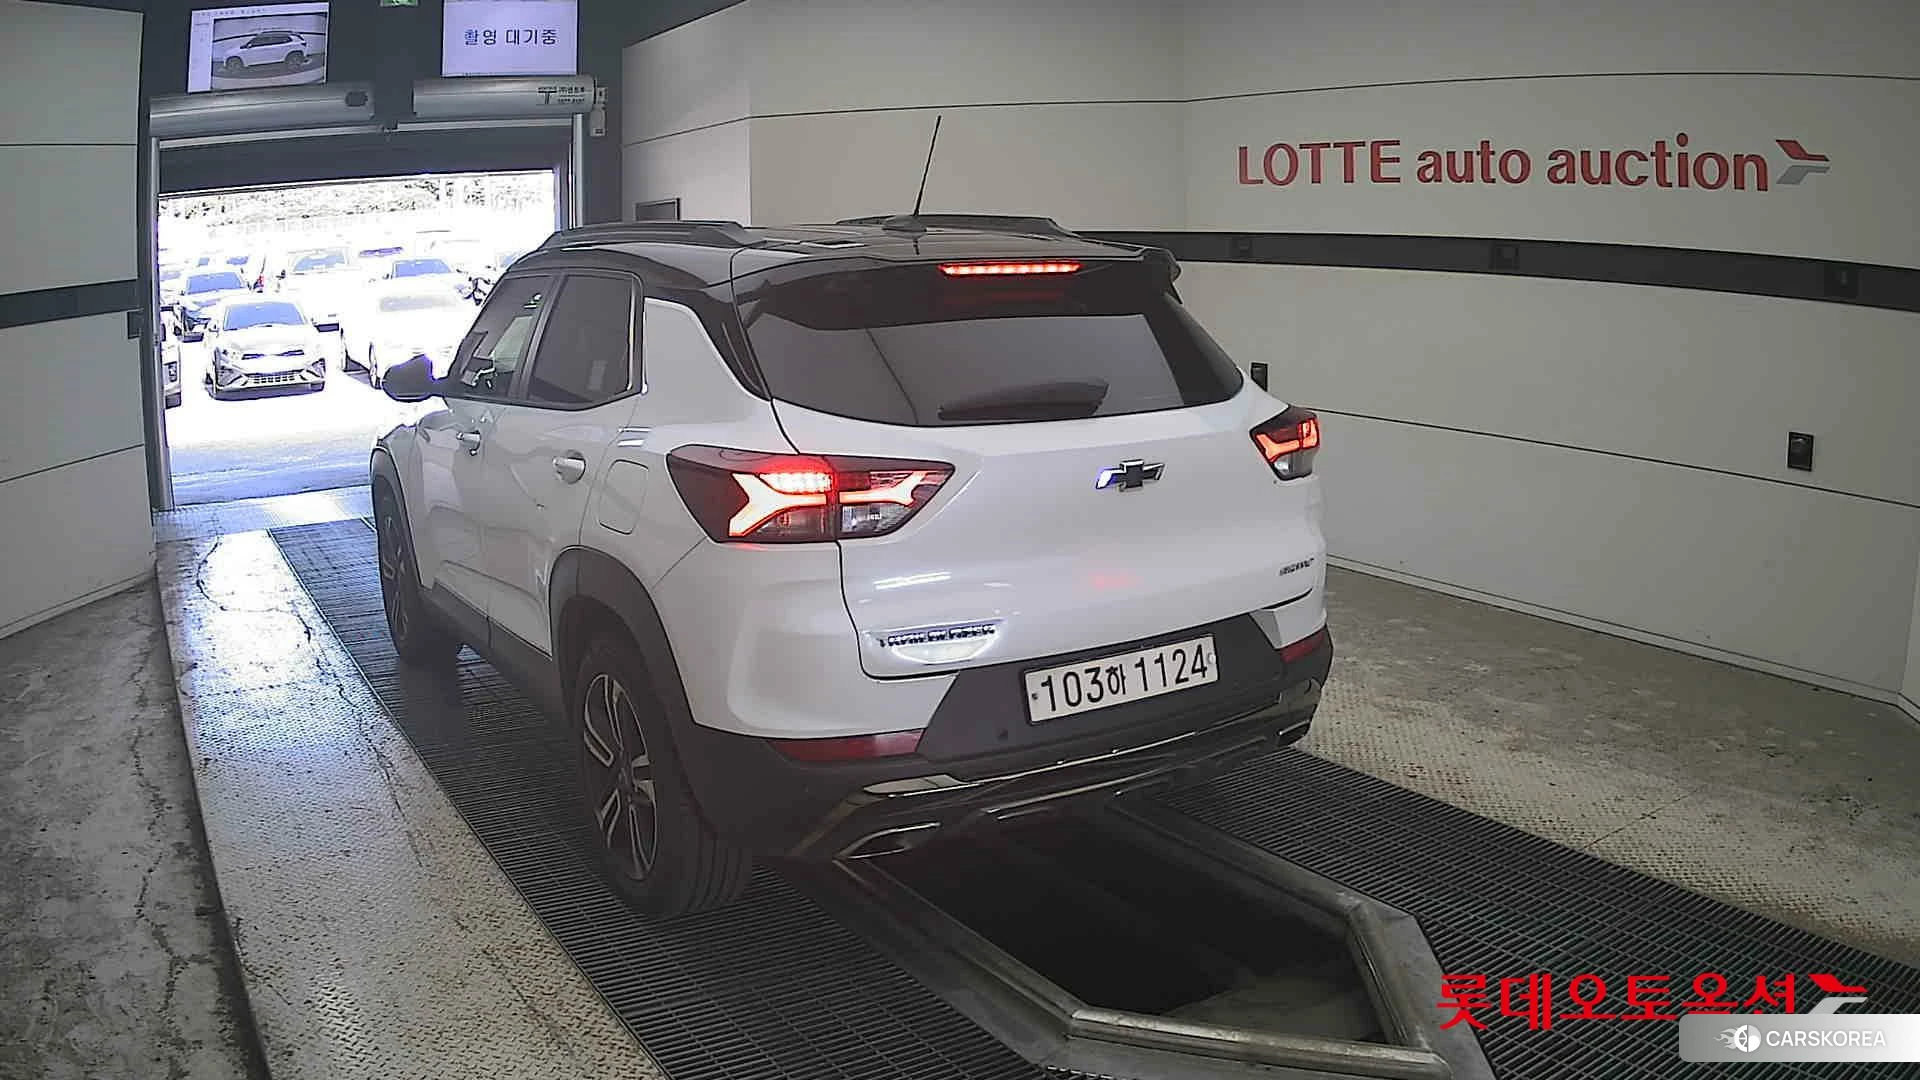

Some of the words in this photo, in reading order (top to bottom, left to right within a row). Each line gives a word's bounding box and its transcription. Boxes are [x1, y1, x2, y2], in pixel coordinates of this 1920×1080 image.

[505, 29, 559, 45] 대기중
[1238, 140, 1401, 185] LOTTE
[1416, 140, 1532, 184] auto
[1547, 132, 1769, 192] auction
[1040, 665, 1127, 712] 103하
[1134, 643, 1208, 692] 1124
